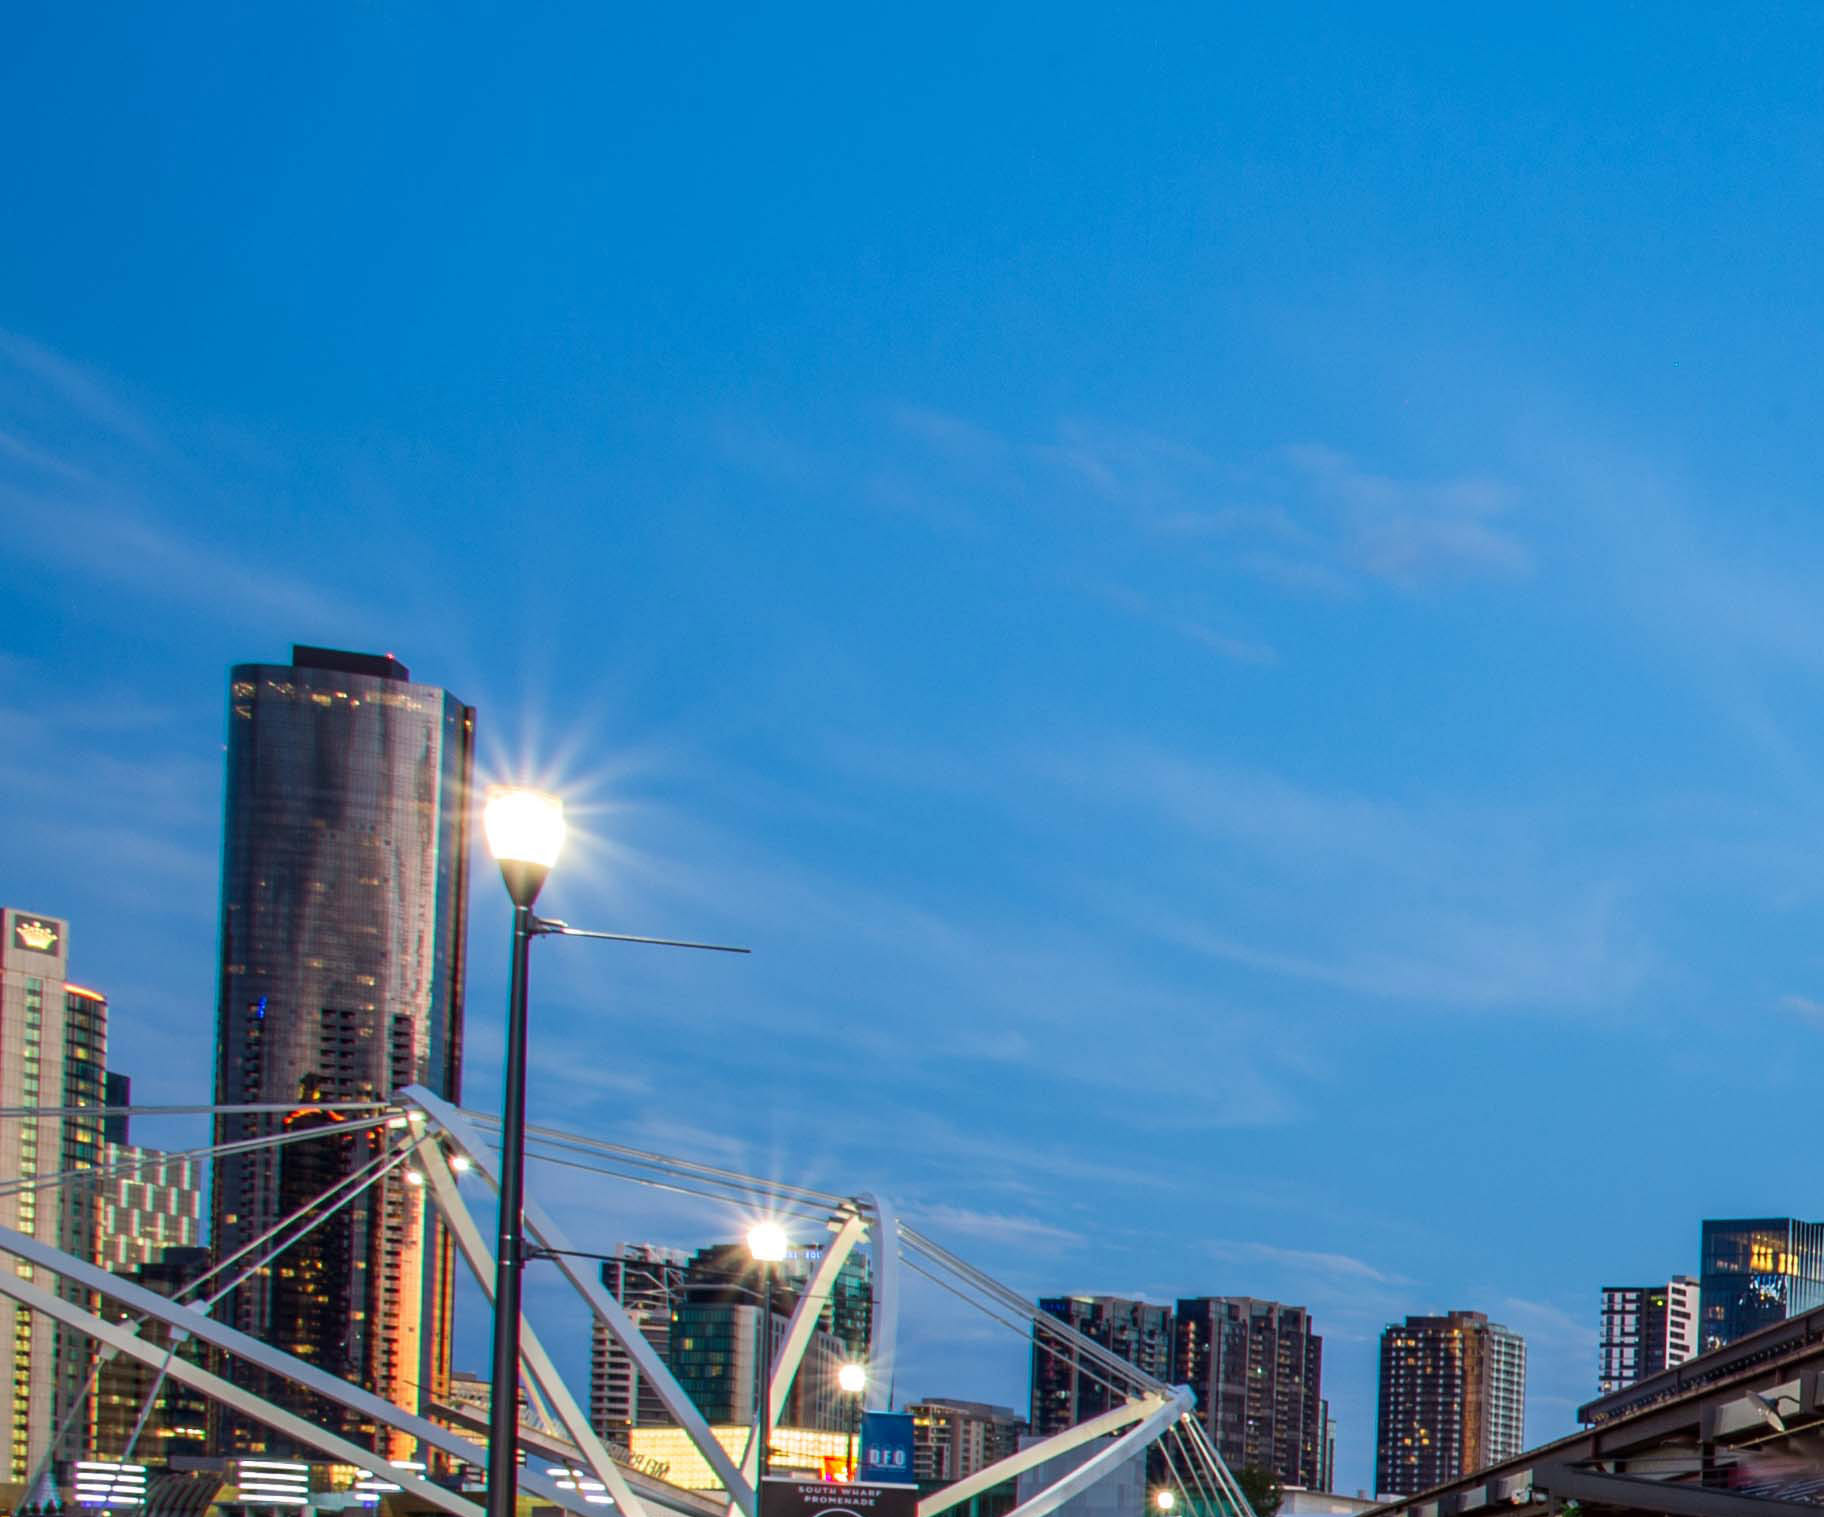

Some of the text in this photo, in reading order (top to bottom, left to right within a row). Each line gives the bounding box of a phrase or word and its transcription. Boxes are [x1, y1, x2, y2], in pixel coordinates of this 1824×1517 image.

[869, 1448, 906, 1466] DFO
[798, 1486, 883, 1497] SOUTH WHARF
[804, 1496, 876, 1506] PROMENADE
